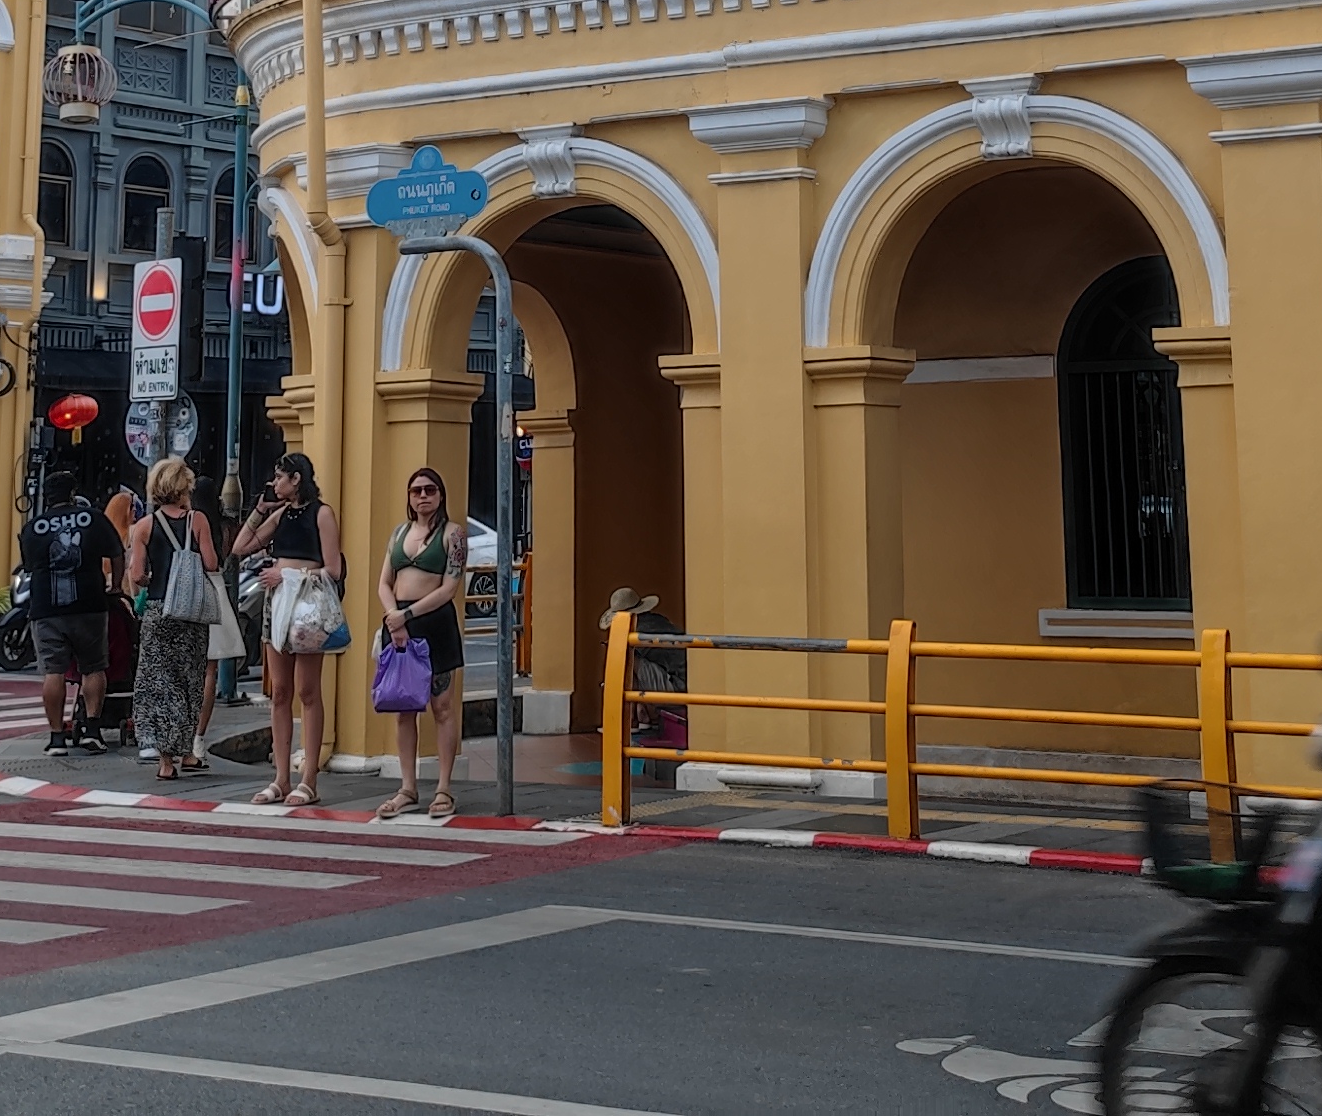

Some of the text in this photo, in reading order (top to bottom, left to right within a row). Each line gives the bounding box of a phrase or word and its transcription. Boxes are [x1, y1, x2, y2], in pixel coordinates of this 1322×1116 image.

[397, 174, 456, 204] ถนนภูเก็ต
[402, 202, 451, 215] PHUKET ROAD
[137, 381, 170, 393] NO ENTRY
[33, 511, 92, 535] OSHO
